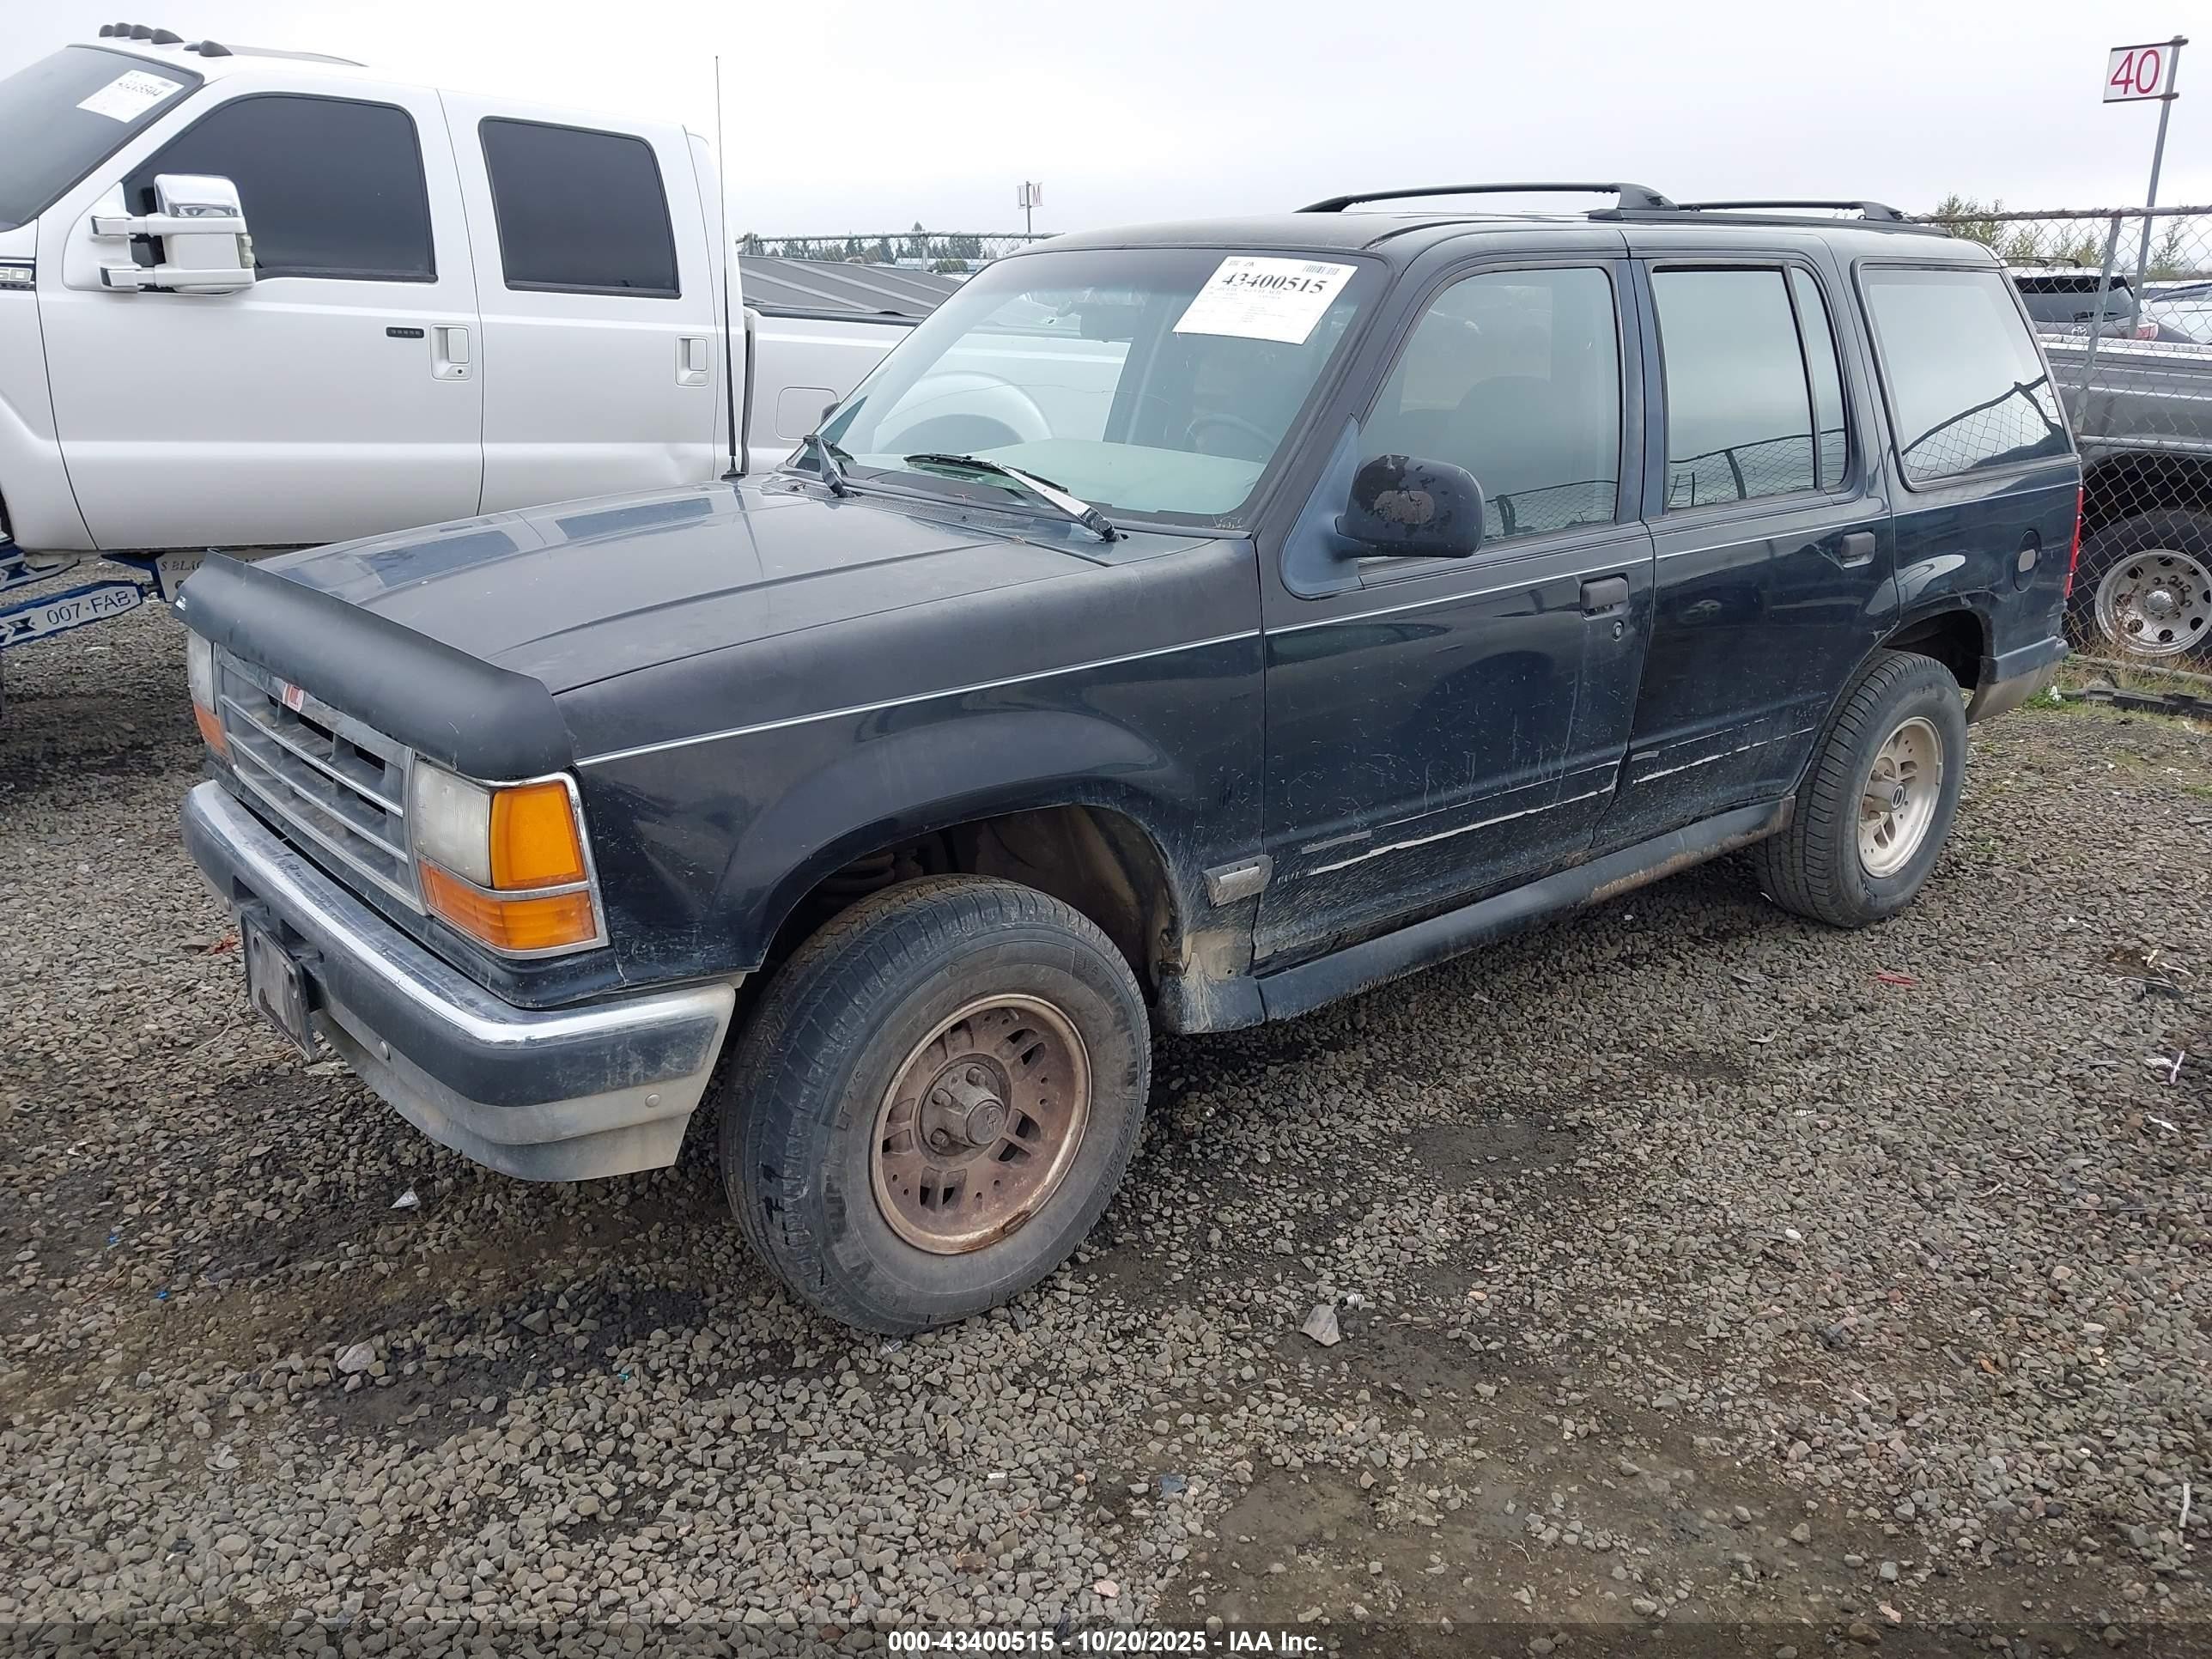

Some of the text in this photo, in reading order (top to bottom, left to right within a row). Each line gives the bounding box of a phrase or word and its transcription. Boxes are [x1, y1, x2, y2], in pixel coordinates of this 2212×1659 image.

[2111, 50, 2160, 94] 40
[1033, 185, 1040, 204] M
[1222, 271, 1328, 294] 43400515
[46, 591, 131, 625] 007 FAB
[1097, 980, 1139, 1087] MICHELIN
